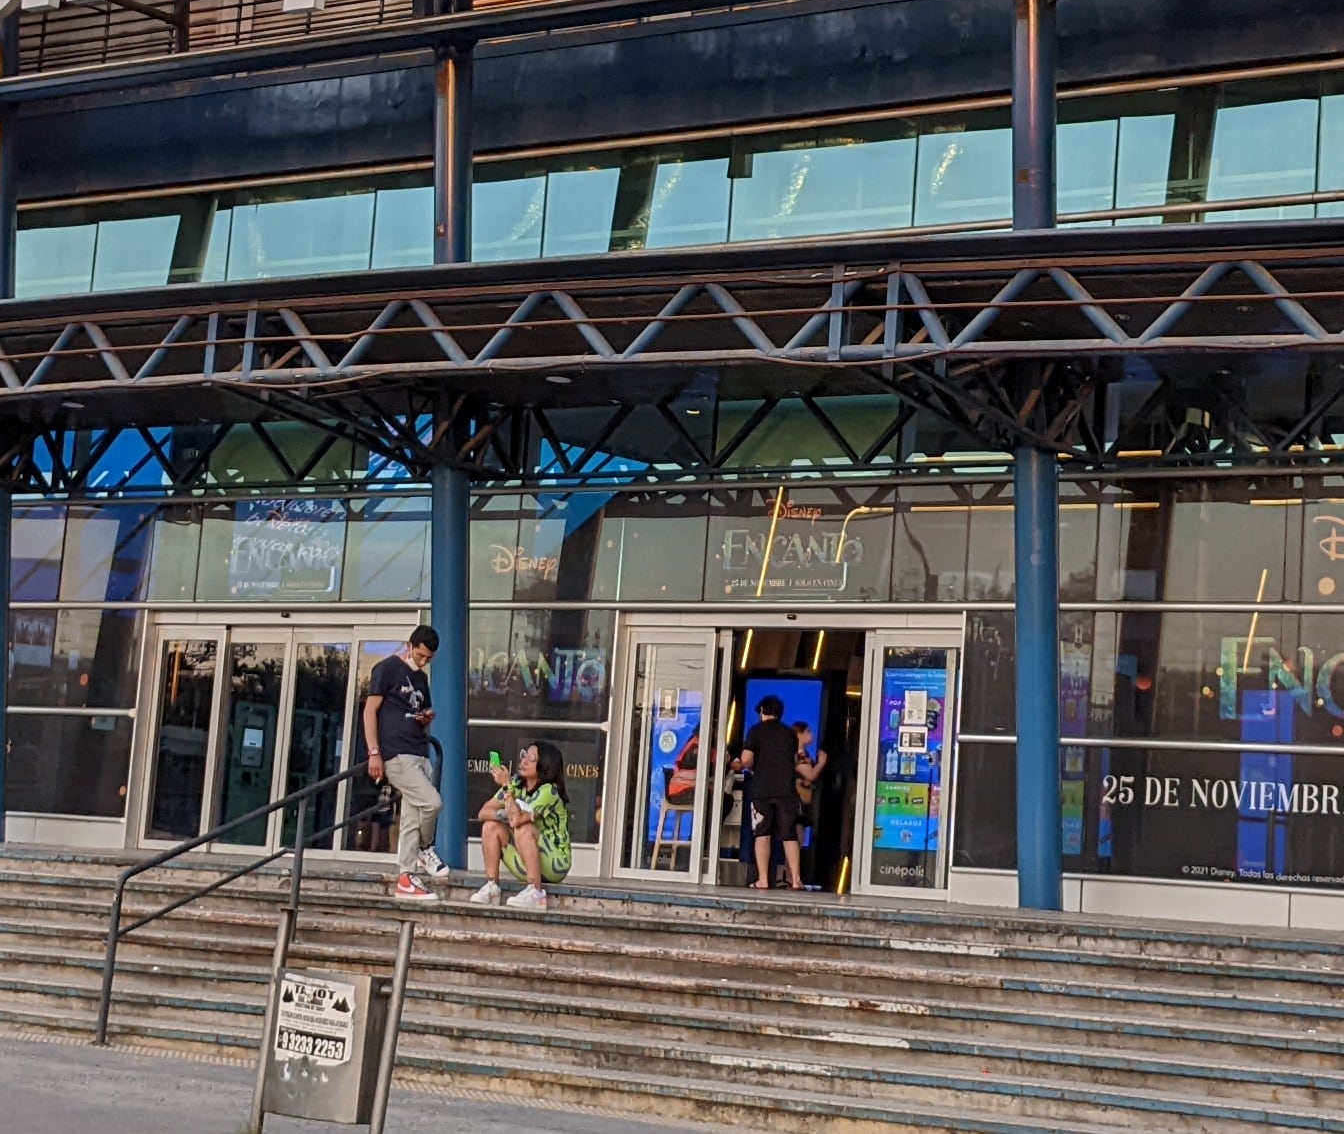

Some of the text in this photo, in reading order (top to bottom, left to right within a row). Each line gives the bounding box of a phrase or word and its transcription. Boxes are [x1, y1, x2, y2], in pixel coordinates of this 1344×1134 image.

[723, 529, 864, 570] ENCANTO
[490, 544, 557, 580] Disney
[567, 763, 600, 779] CINES
[1102, 775, 1135, 805] 25
[1144, 776, 1180, 806] DE
[1239, 868, 1261, 879] Todos
[1276, 873, 1310, 883] derechos
[295, 983, 337, 1000] TAOT
